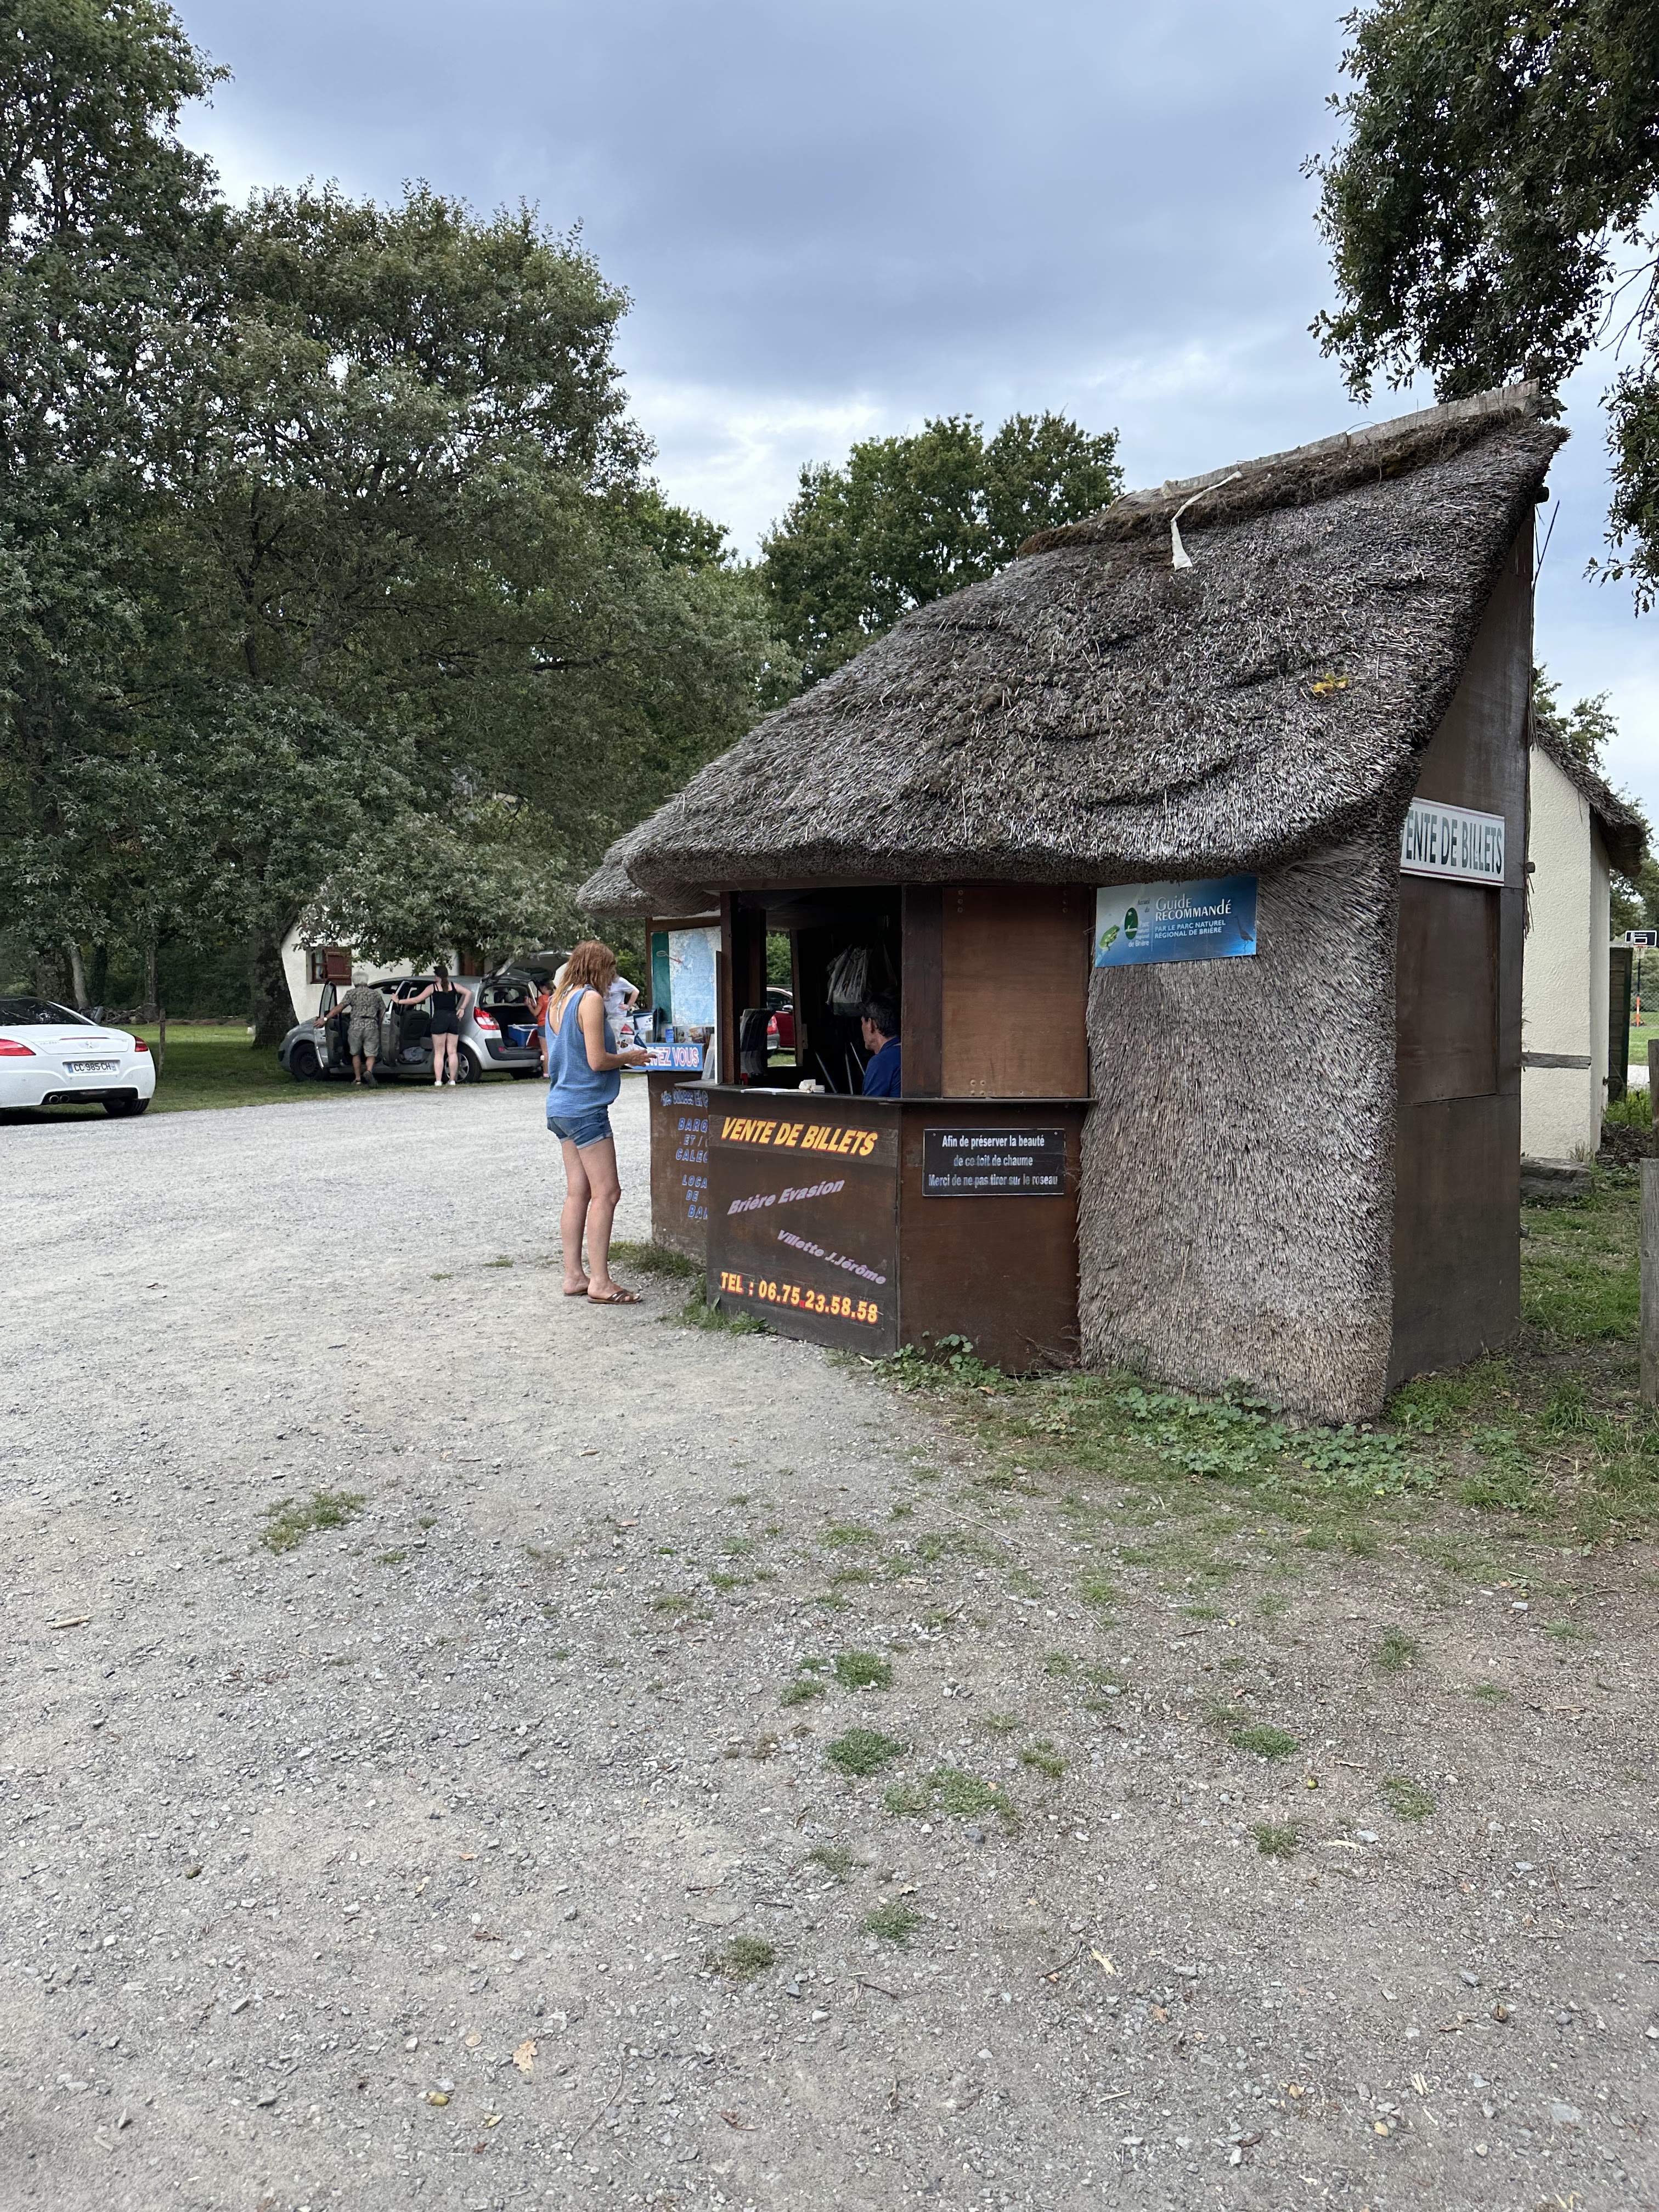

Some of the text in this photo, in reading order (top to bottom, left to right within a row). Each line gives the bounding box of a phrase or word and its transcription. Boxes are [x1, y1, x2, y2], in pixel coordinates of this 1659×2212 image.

[1401, 809, 1502, 874] ENTE DE BILLETS
[1195, 919, 1226, 928] NATUREL
[1154, 931, 1187, 939] RÉGIONAL
[1199, 926, 1222, 935] BRIÈRE
[672, 1047, 699, 1067] VOUS
[684, 1134, 696, 1146] ET
[721, 1116, 878, 1156] VENTE DE BILLETS
[942, 1134, 1045, 1150] Afin de préserver la beauté
[953, 1154, 963, 1167] de
[965, 1156, 975, 1167] ce
[991, 1154, 1001, 1166] de
[1003, 1154, 1033, 1166] chaume
[928, 1173, 1058, 1188] Merci de ne pas tirer sur le roseau
[686, 1189, 699, 1202] DE
[727, 1180, 845, 1216] Brière Evasion
[776, 1229, 887, 1285] Villette J.Jérôme
[720, 1272, 744, 1295] TEL
